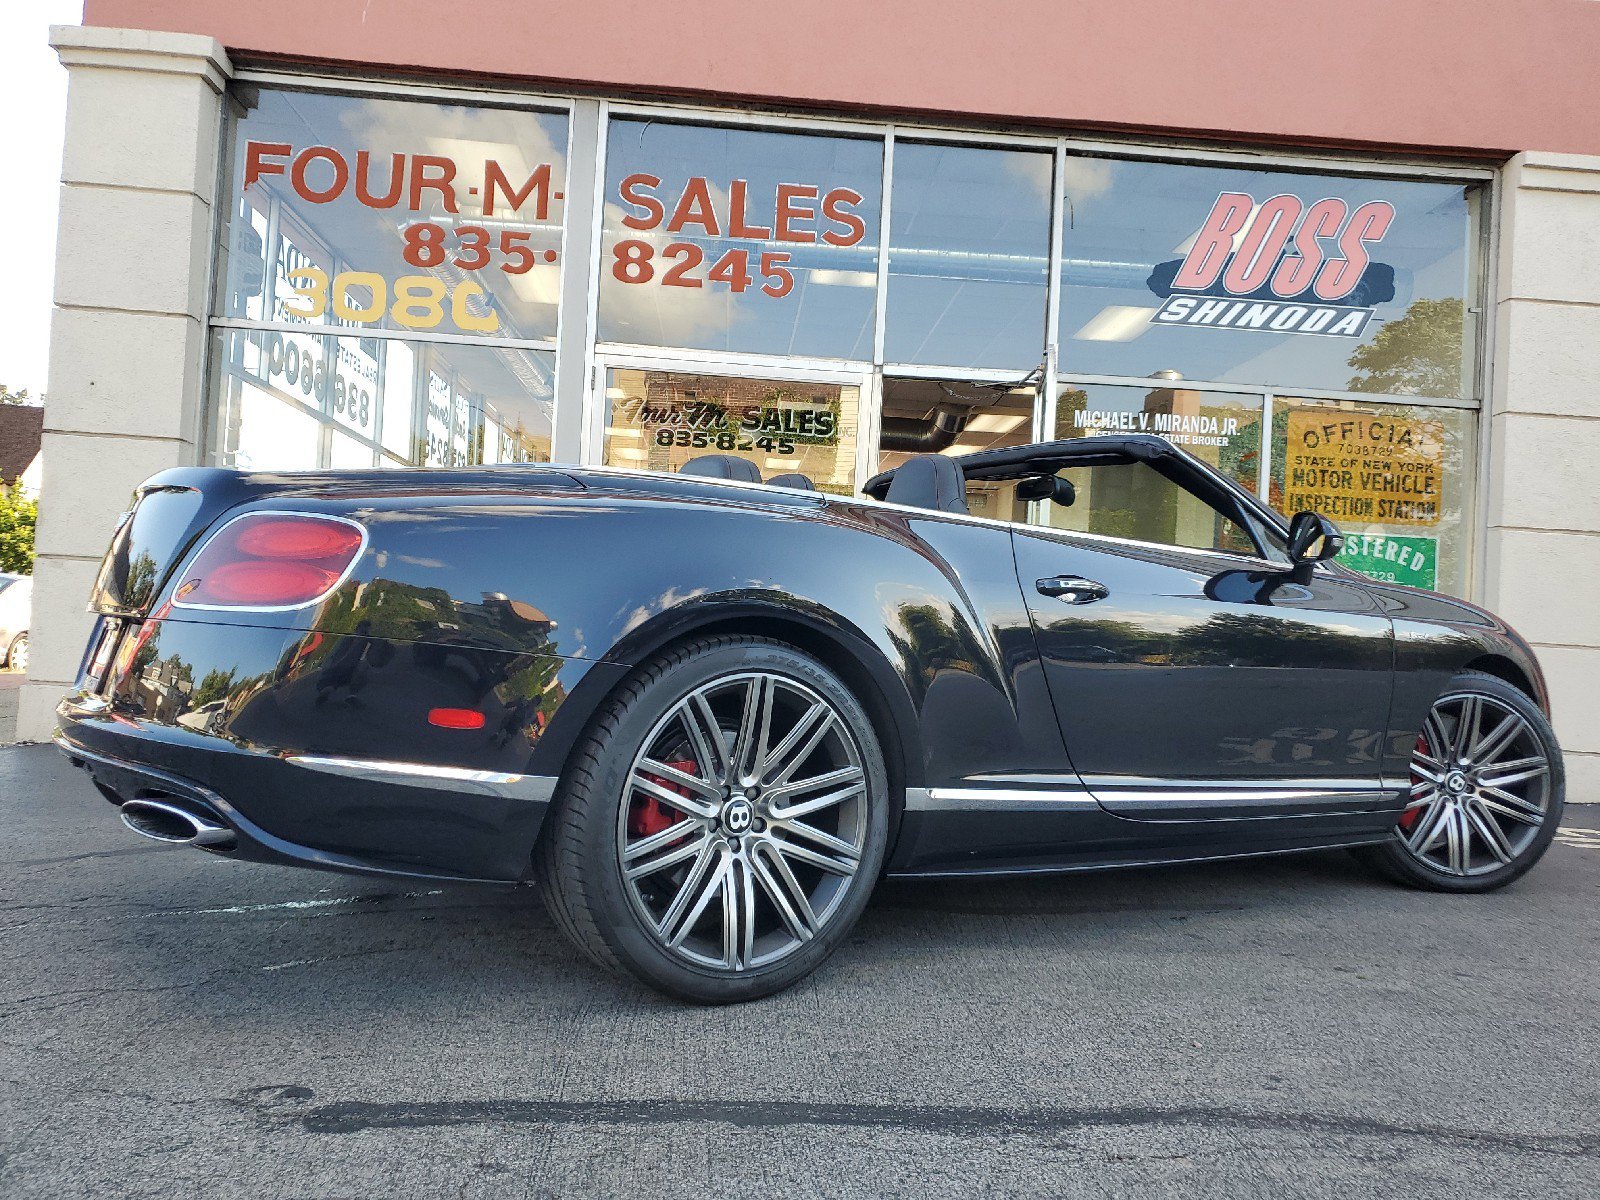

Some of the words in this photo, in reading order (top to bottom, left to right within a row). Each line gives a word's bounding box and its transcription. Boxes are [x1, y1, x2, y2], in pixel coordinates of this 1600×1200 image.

[618, 173, 866, 247] SALES
[1170, 191, 1397, 300] BOSS
[611, 239, 794, 298] 8245
[1158, 297, 1367, 335] SHINODA
[741, 404, 834, 438] SALES
[1074, 409, 1136, 430] MICHAEL
[1138, 412, 1151, 431] V.
[1154, 413, 1219, 435] MIRANDA
[1220, 418, 1241, 436] JR.
[1303, 421, 1424, 449] OFFICIA
[1192, 436, 1229, 447] BROKER
[1295, 455, 1336, 467] STATE
[1340, 458, 1359, 469] OF
[1362, 460, 1392, 472] NEW
[1397, 462, 1434, 474] YORK
[1292, 468, 1353, 489] MOTOR
[1358, 471, 1436, 496] VEHICLE
[1289, 492, 1374, 517] INSPECTION
[1377, 498, 1437, 520] STATION
